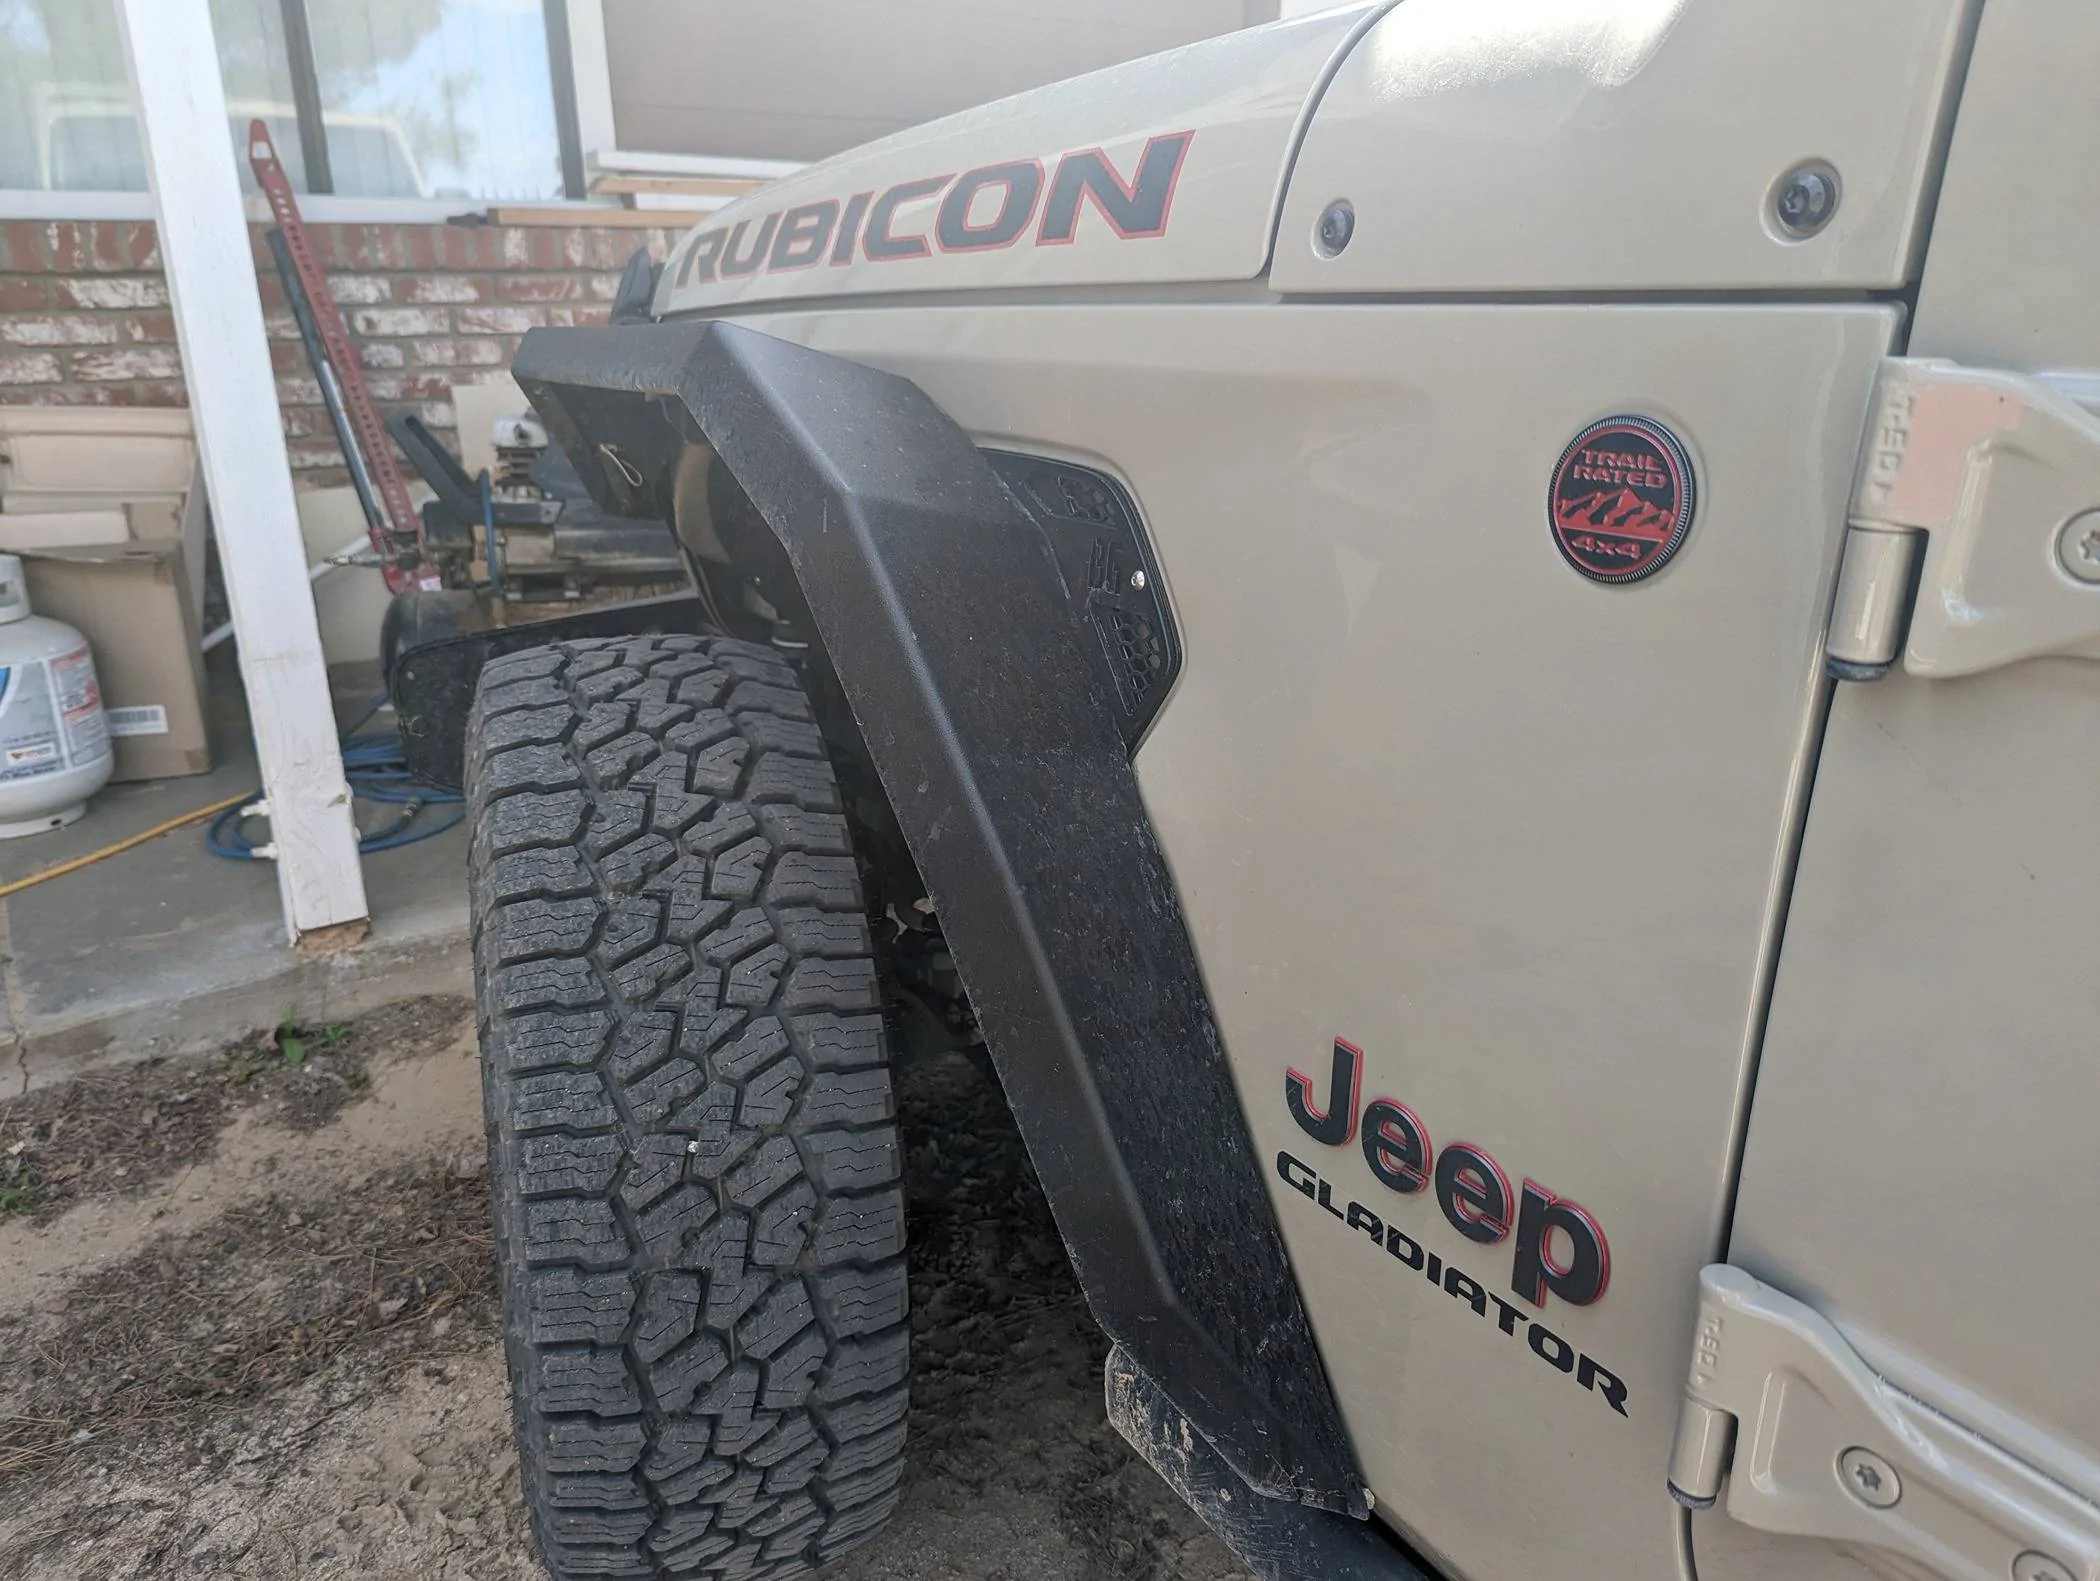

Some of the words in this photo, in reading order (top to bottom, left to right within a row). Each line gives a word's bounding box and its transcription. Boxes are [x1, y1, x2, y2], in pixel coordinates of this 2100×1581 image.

[675, 129, 1196, 289] RUBICON
[1573, 464, 1669, 489] RATED
[1581, 449, 1662, 472] TRAIL
[1285, 1036, 1612, 1310] Jeep
[1276, 1150, 1629, 1418] GLADIATOR
